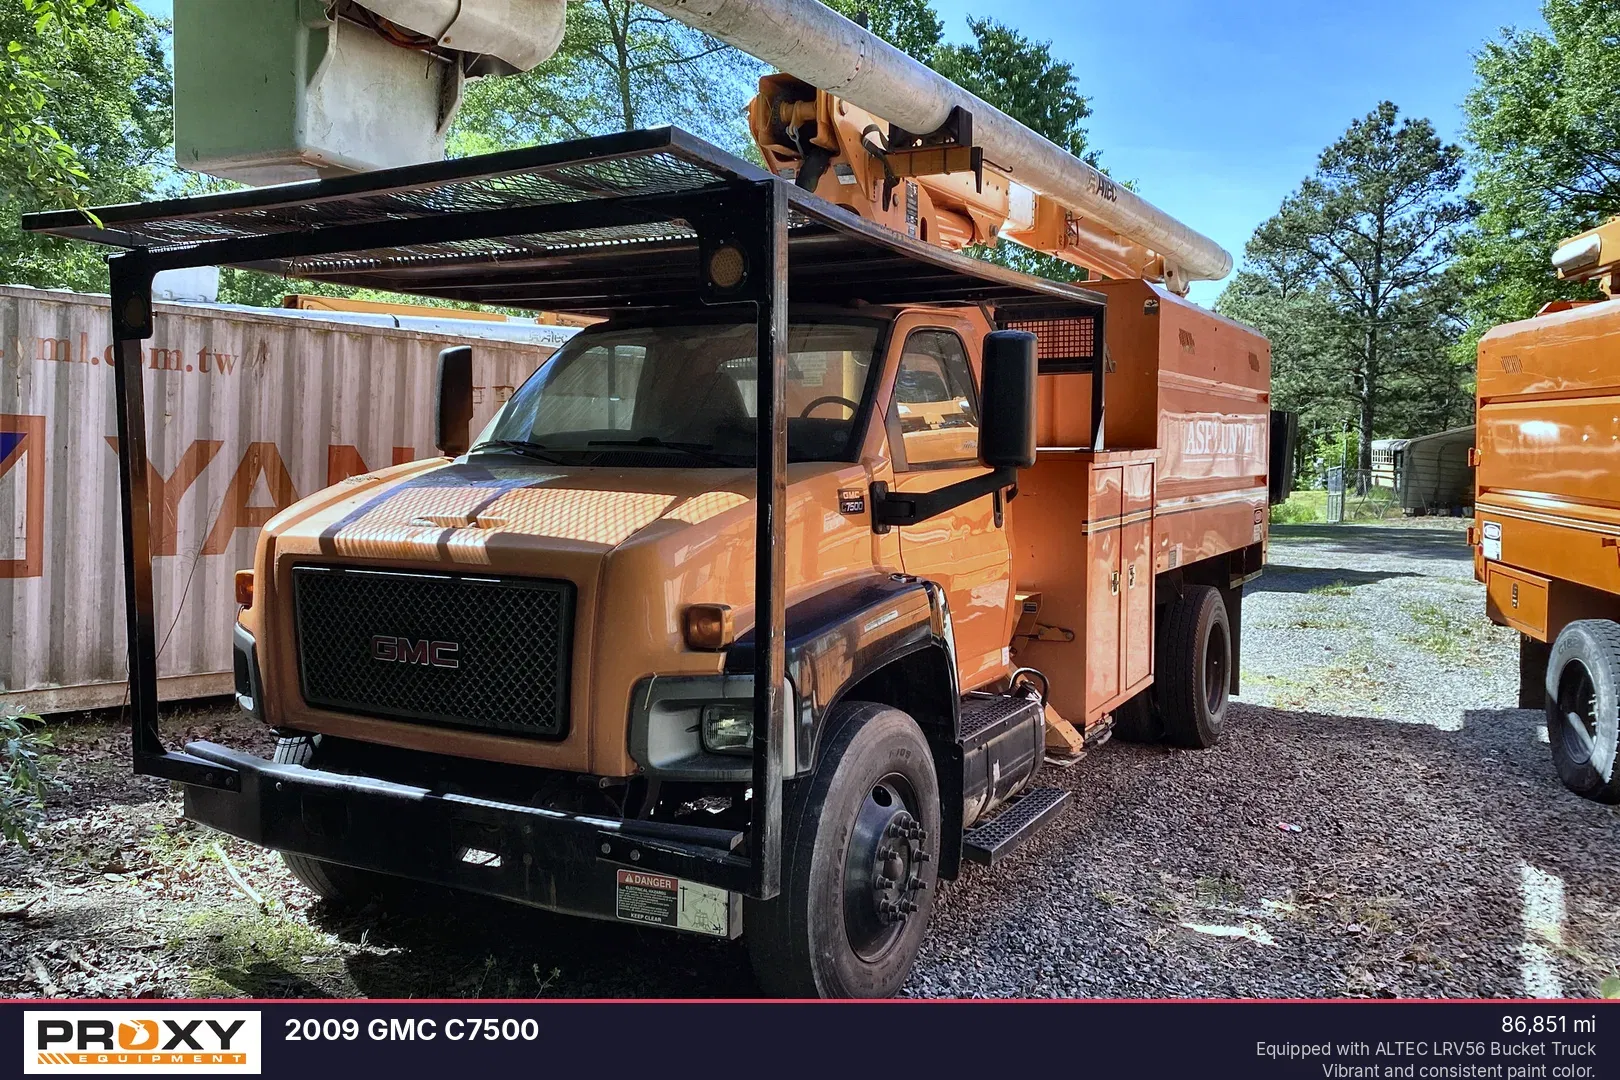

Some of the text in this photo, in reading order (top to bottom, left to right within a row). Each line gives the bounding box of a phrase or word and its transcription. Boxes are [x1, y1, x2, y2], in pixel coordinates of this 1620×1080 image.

[842, 491, 861, 500] GMC
[841, 501, 864, 513] C7500
[371, 634, 459, 669] GMC
[634, 875, 672, 889] DANGER
[630, 912, 662, 923] KEEP CLEAR
